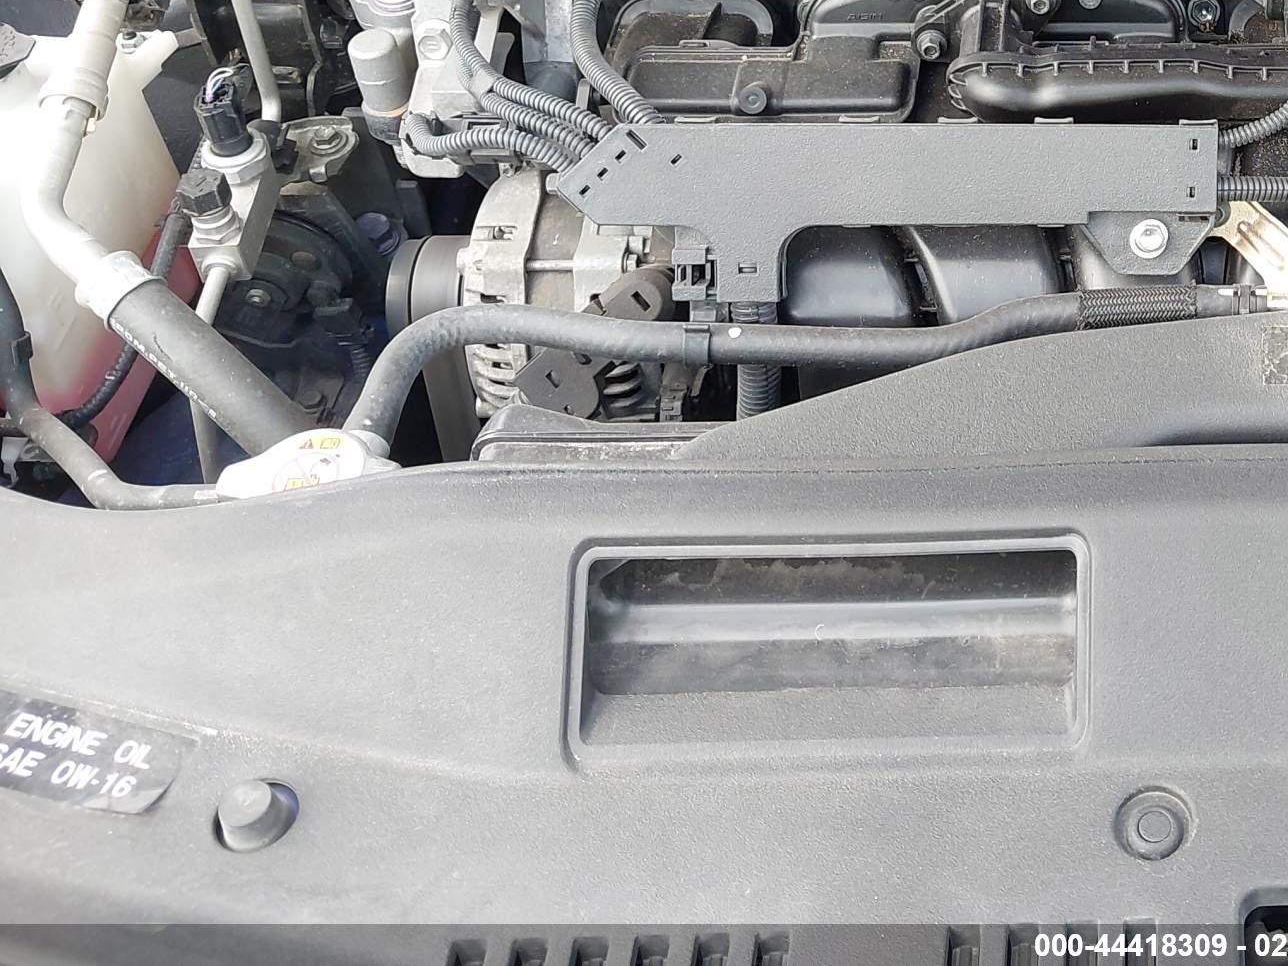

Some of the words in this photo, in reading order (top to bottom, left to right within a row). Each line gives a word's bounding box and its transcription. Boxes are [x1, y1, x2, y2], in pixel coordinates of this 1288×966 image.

[5, 712, 108, 756] ENGINE
[113, 740, 152, 769] OIL
[50, 760, 137, 798] 0W-16
